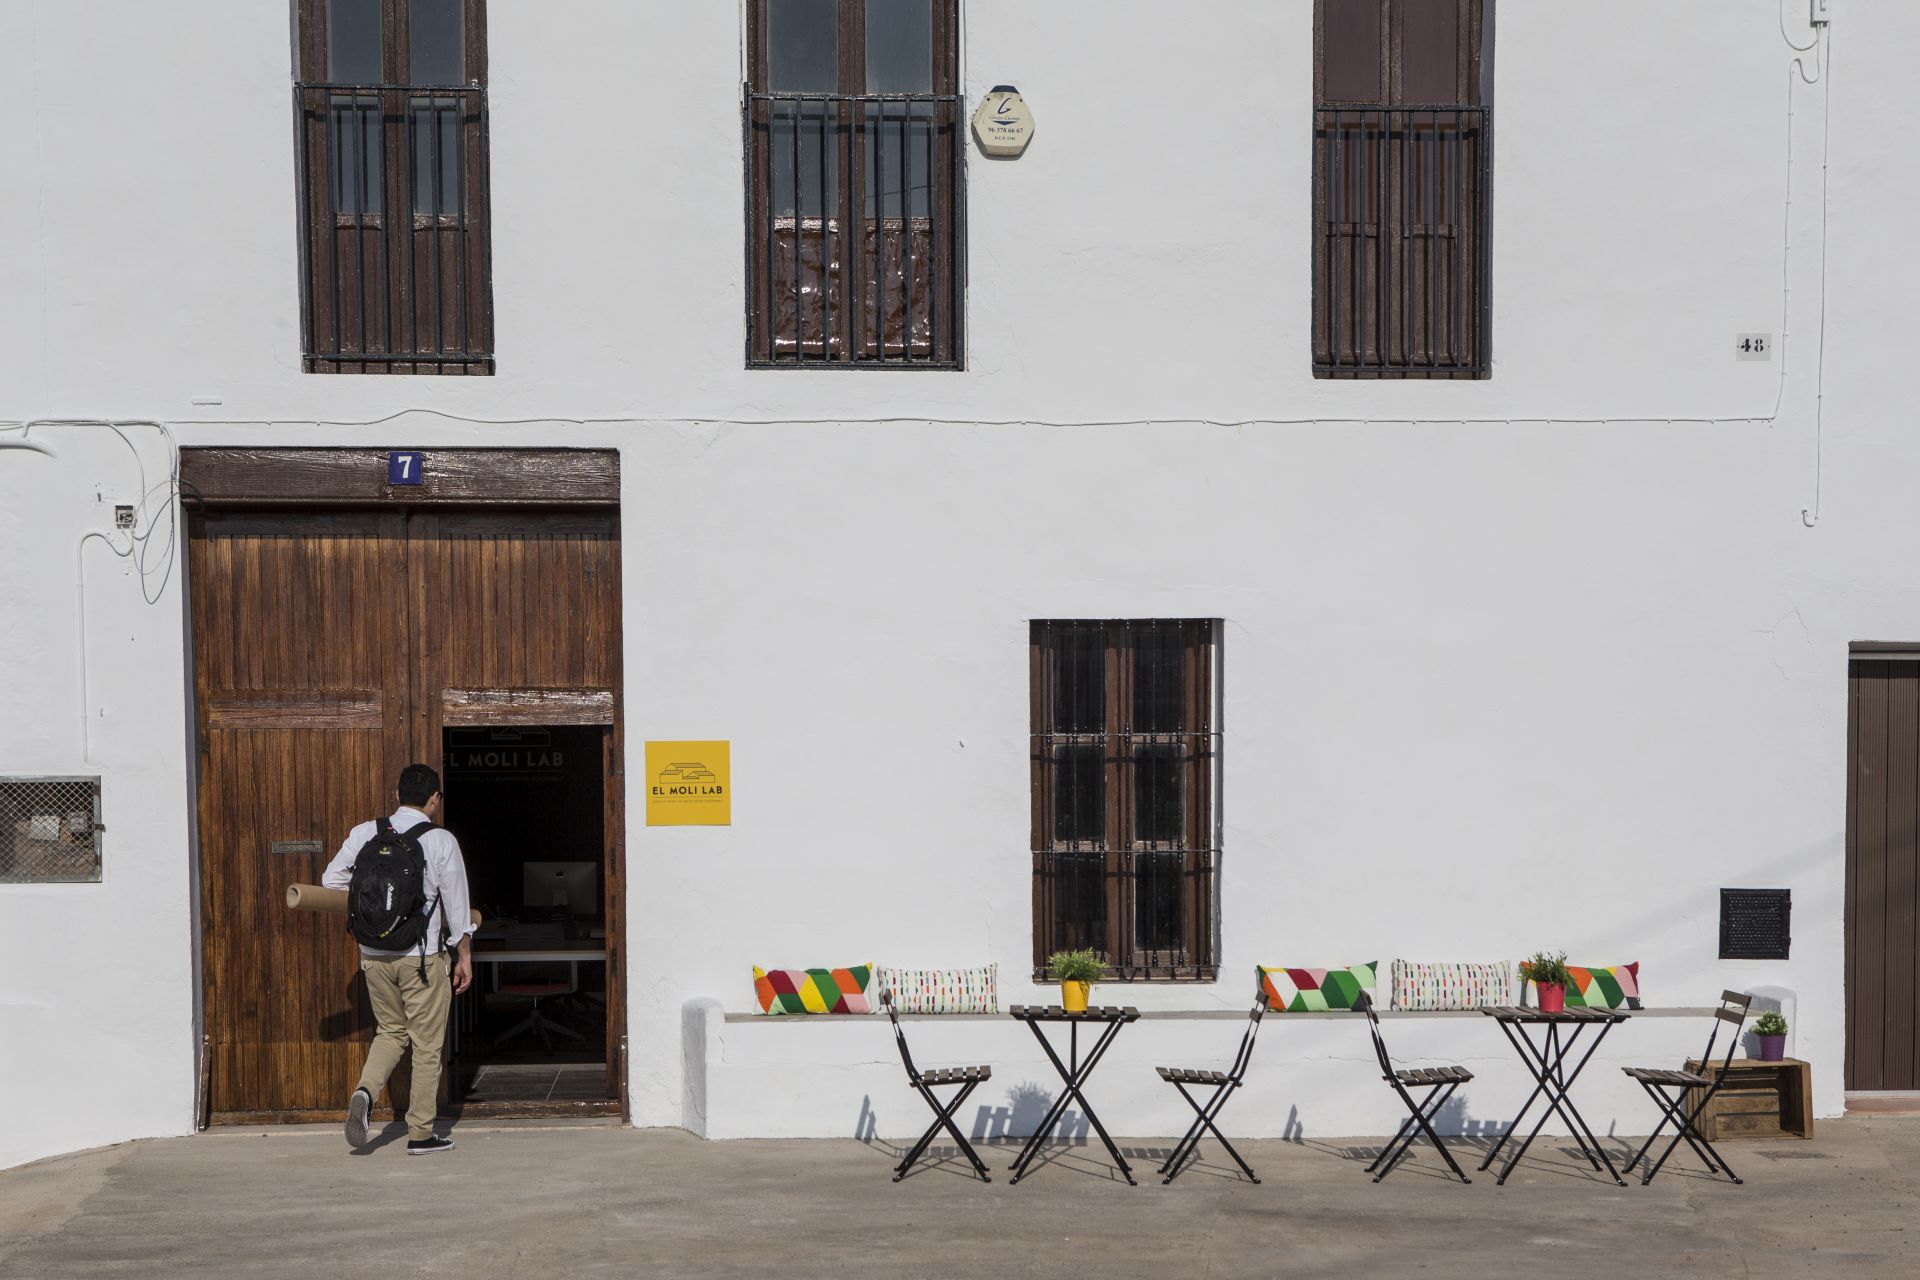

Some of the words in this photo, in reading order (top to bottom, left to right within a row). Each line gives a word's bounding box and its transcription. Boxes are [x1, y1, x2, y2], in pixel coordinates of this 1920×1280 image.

[1740, 338, 1764, 352] 48
[398, 456, 412, 478] 7
[468, 752, 518, 767] MOLI
[527, 752, 564, 767] LAB
[652, 786, 665, 795] EL
[670, 786, 697, 795] MOLI
[702, 786, 723, 794] LAB
